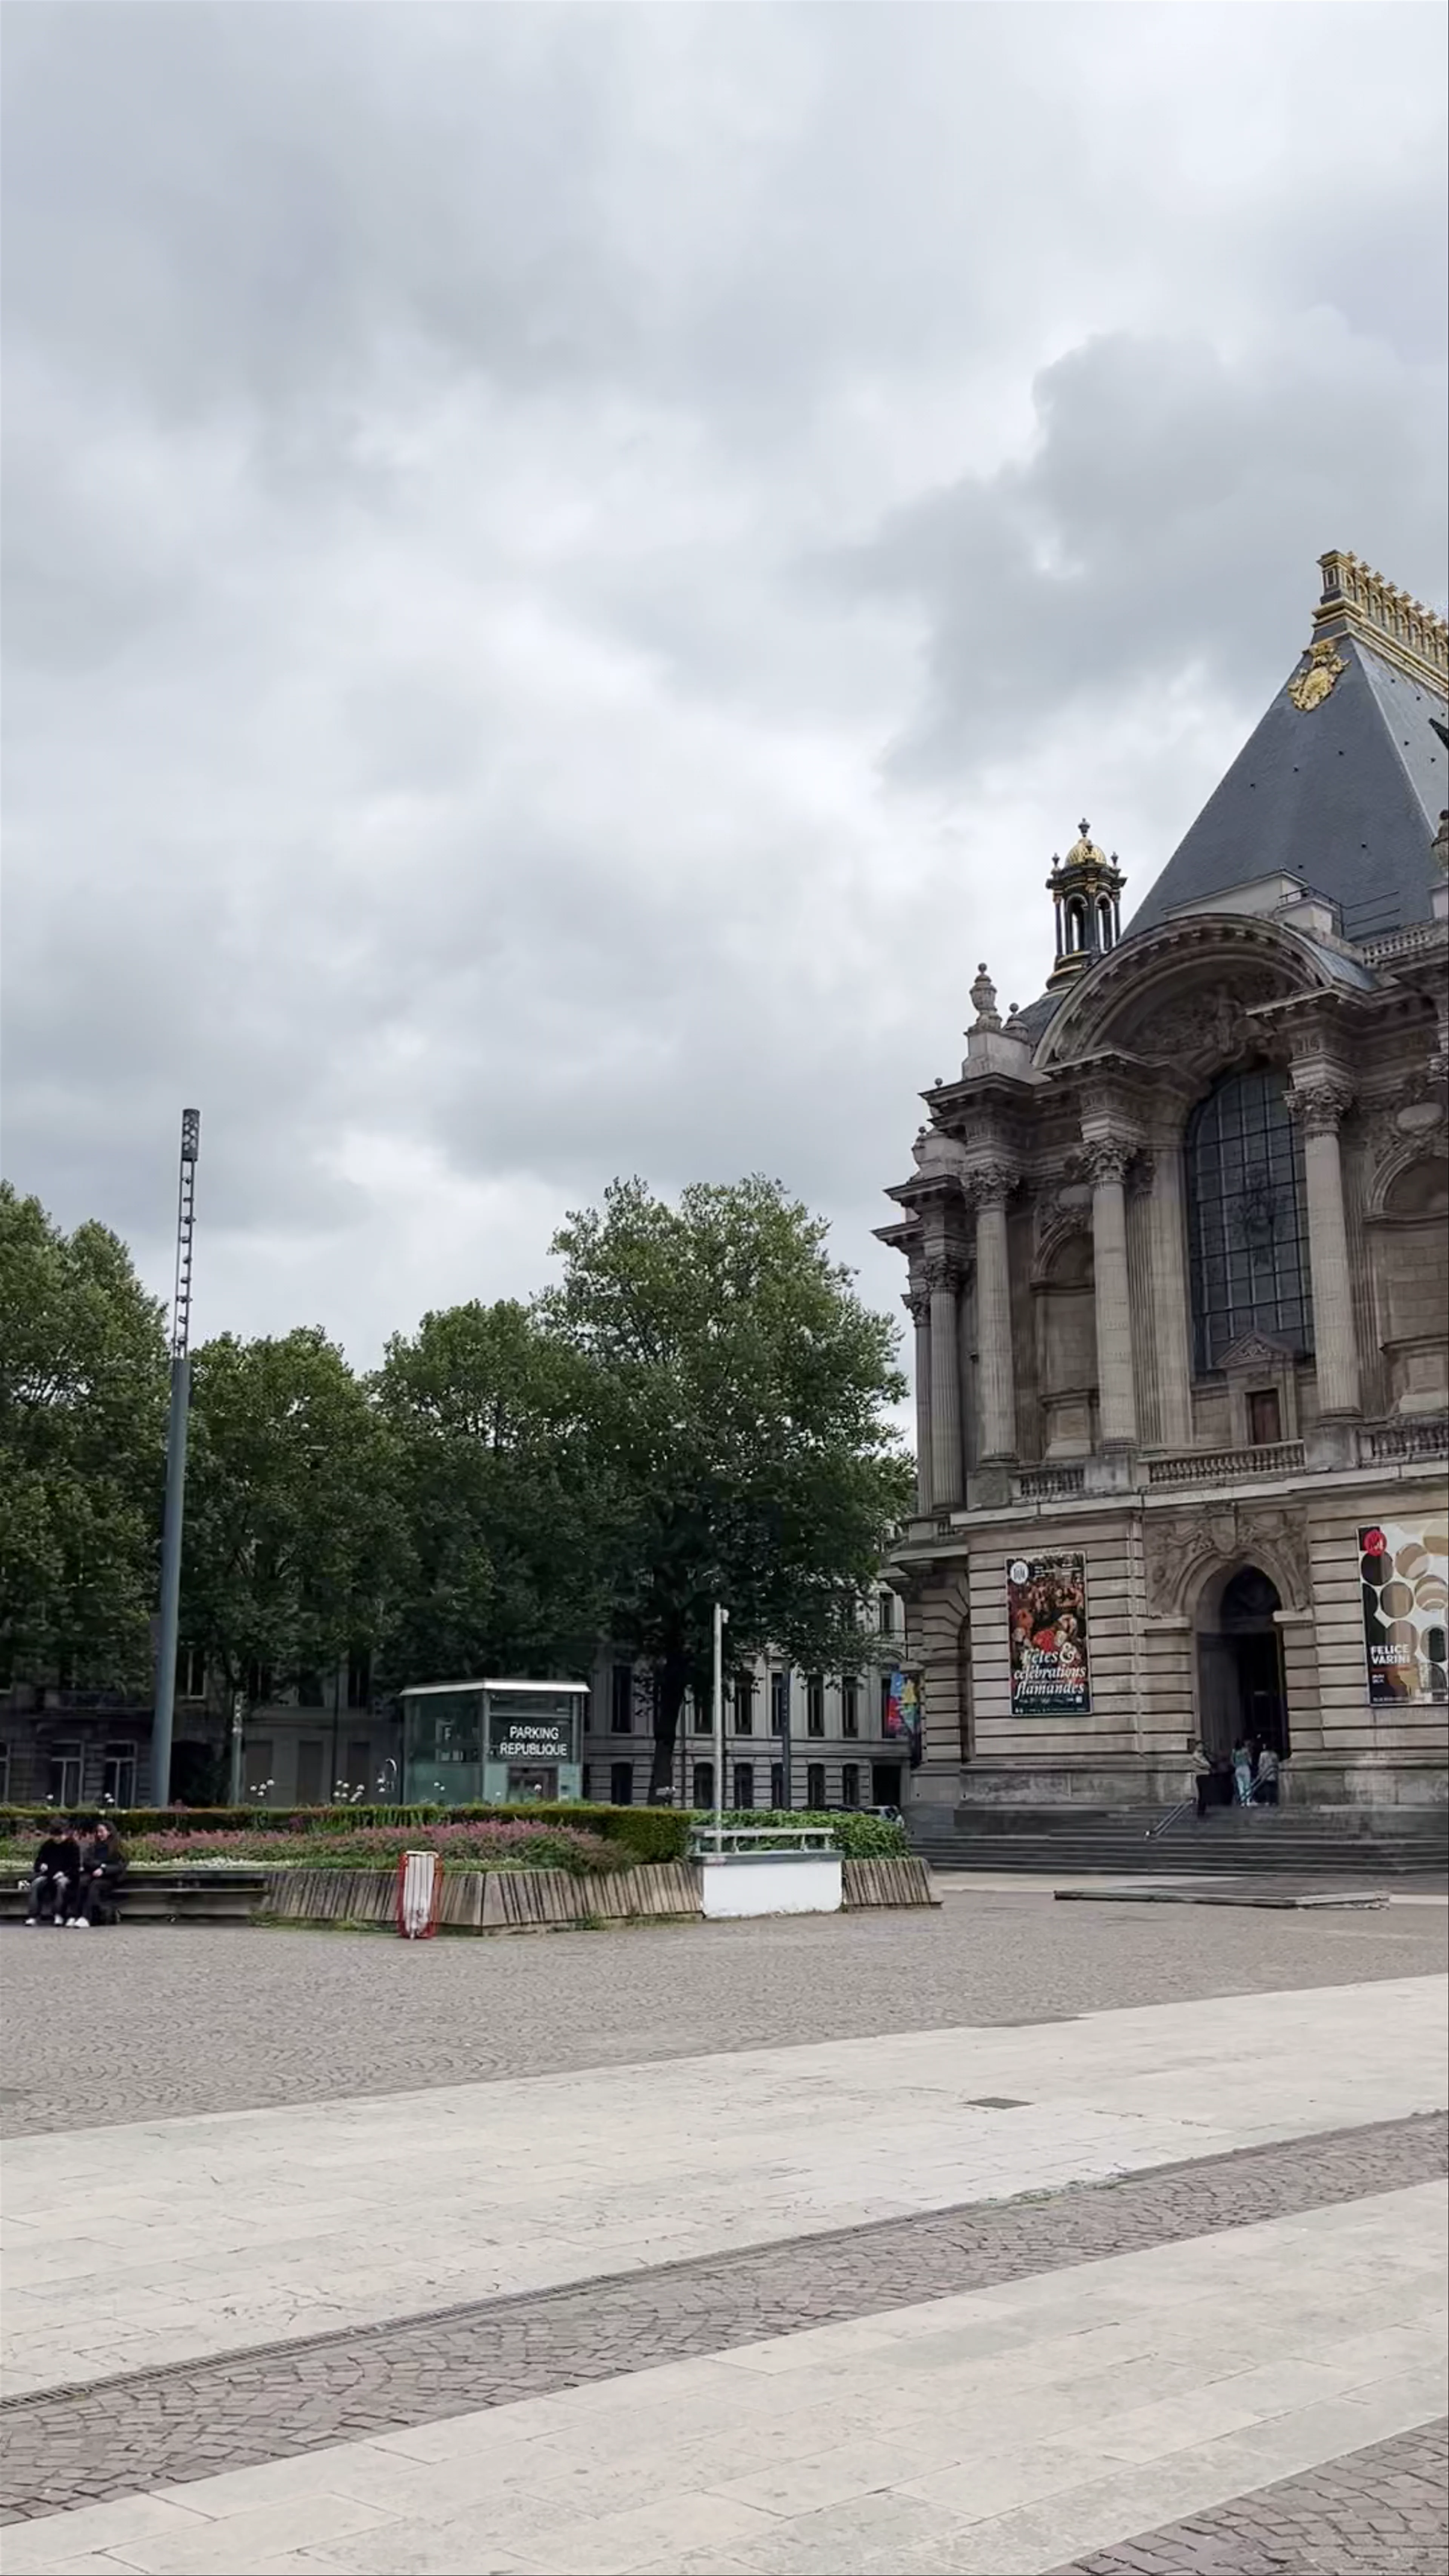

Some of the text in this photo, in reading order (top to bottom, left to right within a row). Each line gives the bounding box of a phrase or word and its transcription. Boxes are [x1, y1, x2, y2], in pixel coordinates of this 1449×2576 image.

[1060, 1642, 1076, 1663] &
[1371, 1644, 1410, 1654] FELICE
[1372, 1655, 1410, 1664] VARINI
[1014, 1681, 1084, 1700] flamandes
[510, 1726, 558, 1740] PARKING
